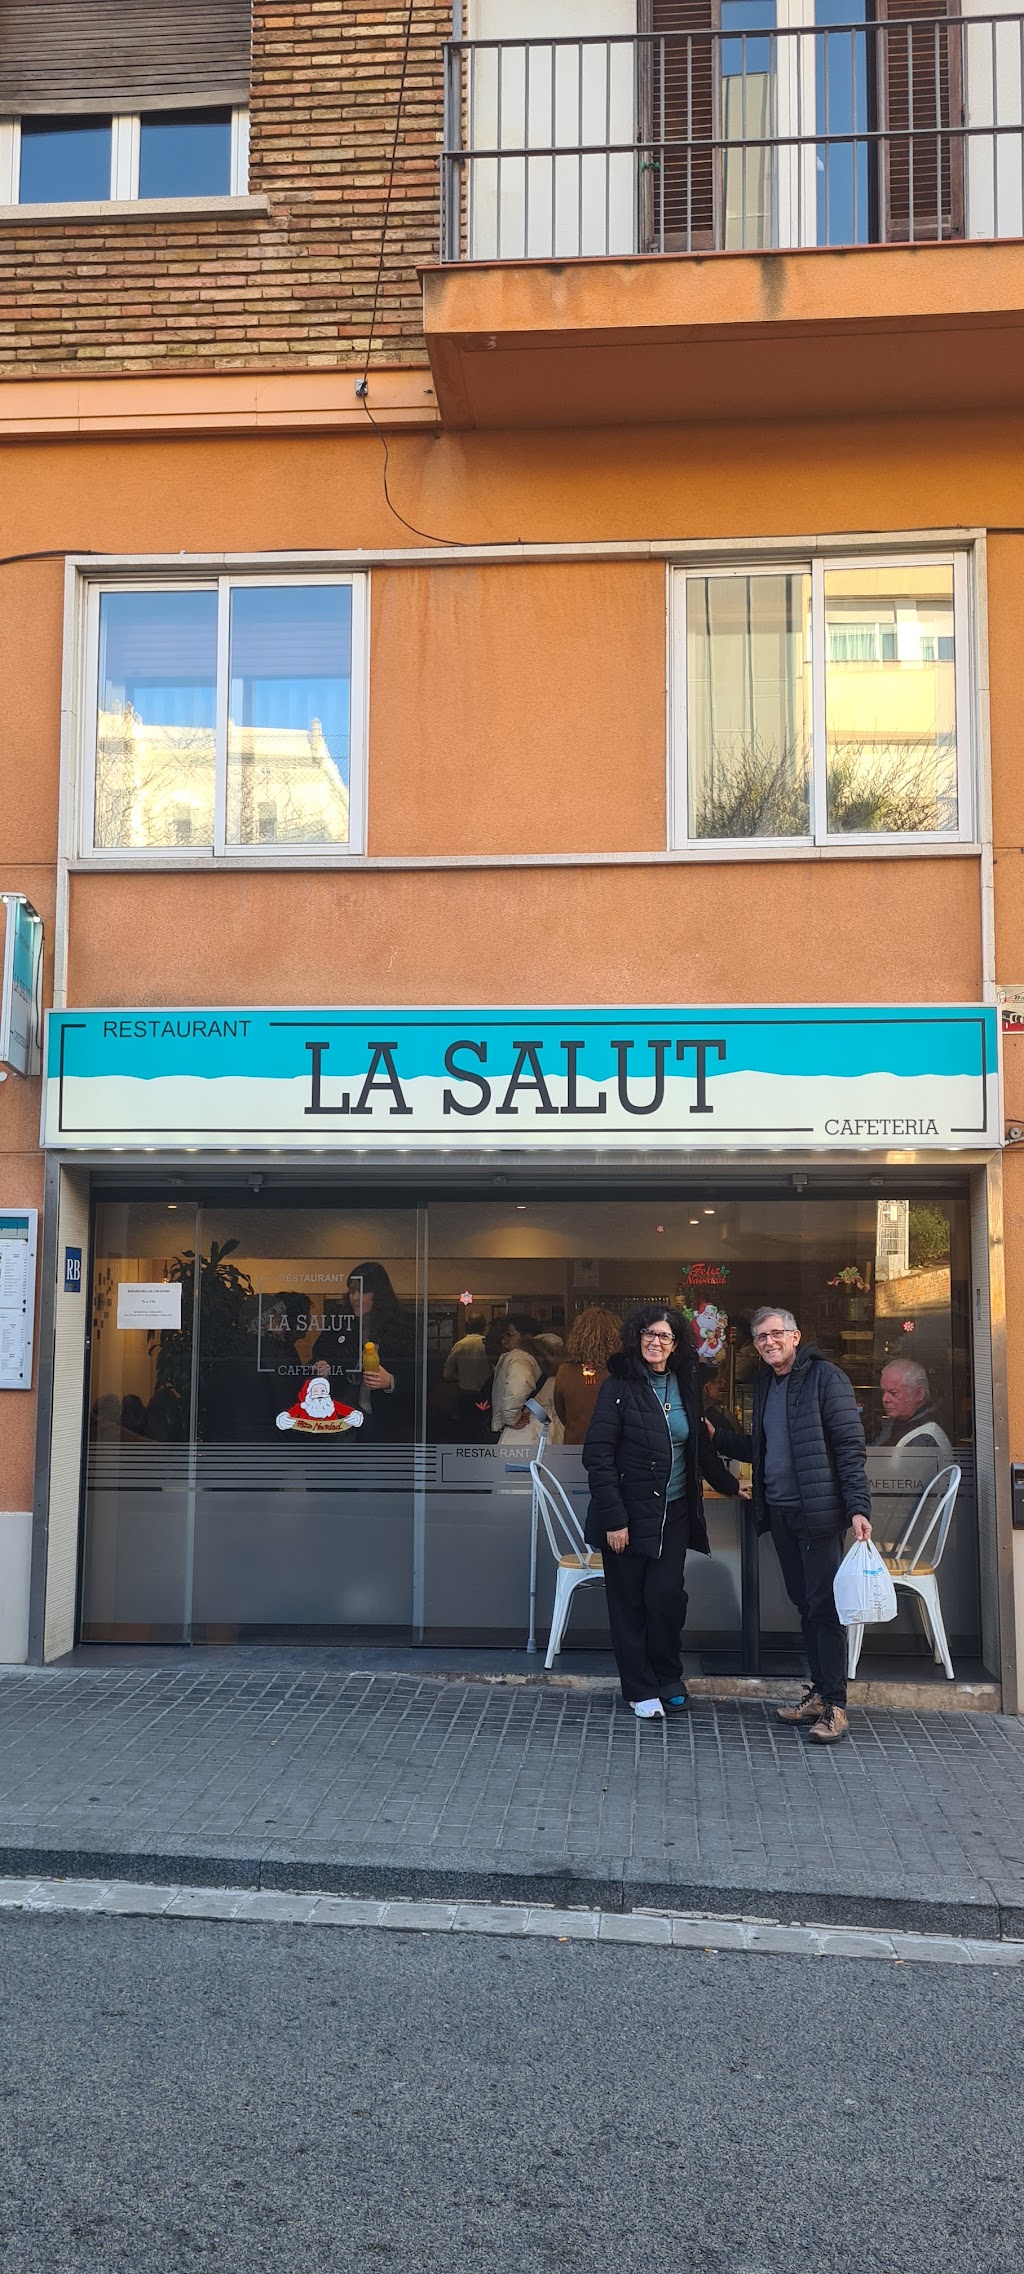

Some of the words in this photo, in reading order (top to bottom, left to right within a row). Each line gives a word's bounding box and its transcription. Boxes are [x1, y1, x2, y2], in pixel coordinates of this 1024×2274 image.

[102, 1020, 252, 1038] RESTAURANT
[304, 1041, 413, 1115] LA
[443, 1039, 726, 1116] SALUT
[824, 1119, 939, 1136] CAFETERIA
[66, 1258, 81, 1281] RB
[690, 1263, 721, 1276] Feliz
[280, 1273, 345, 1283] RESTAURANT
[686, 1273, 727, 1285] Navidad
[267, 1314, 292, 1332] LA
[296, 1314, 355, 1332] SALUT
[456, 1448, 531, 1458] RESTAURANT
[868, 1479, 924, 1489] AFETERIA
